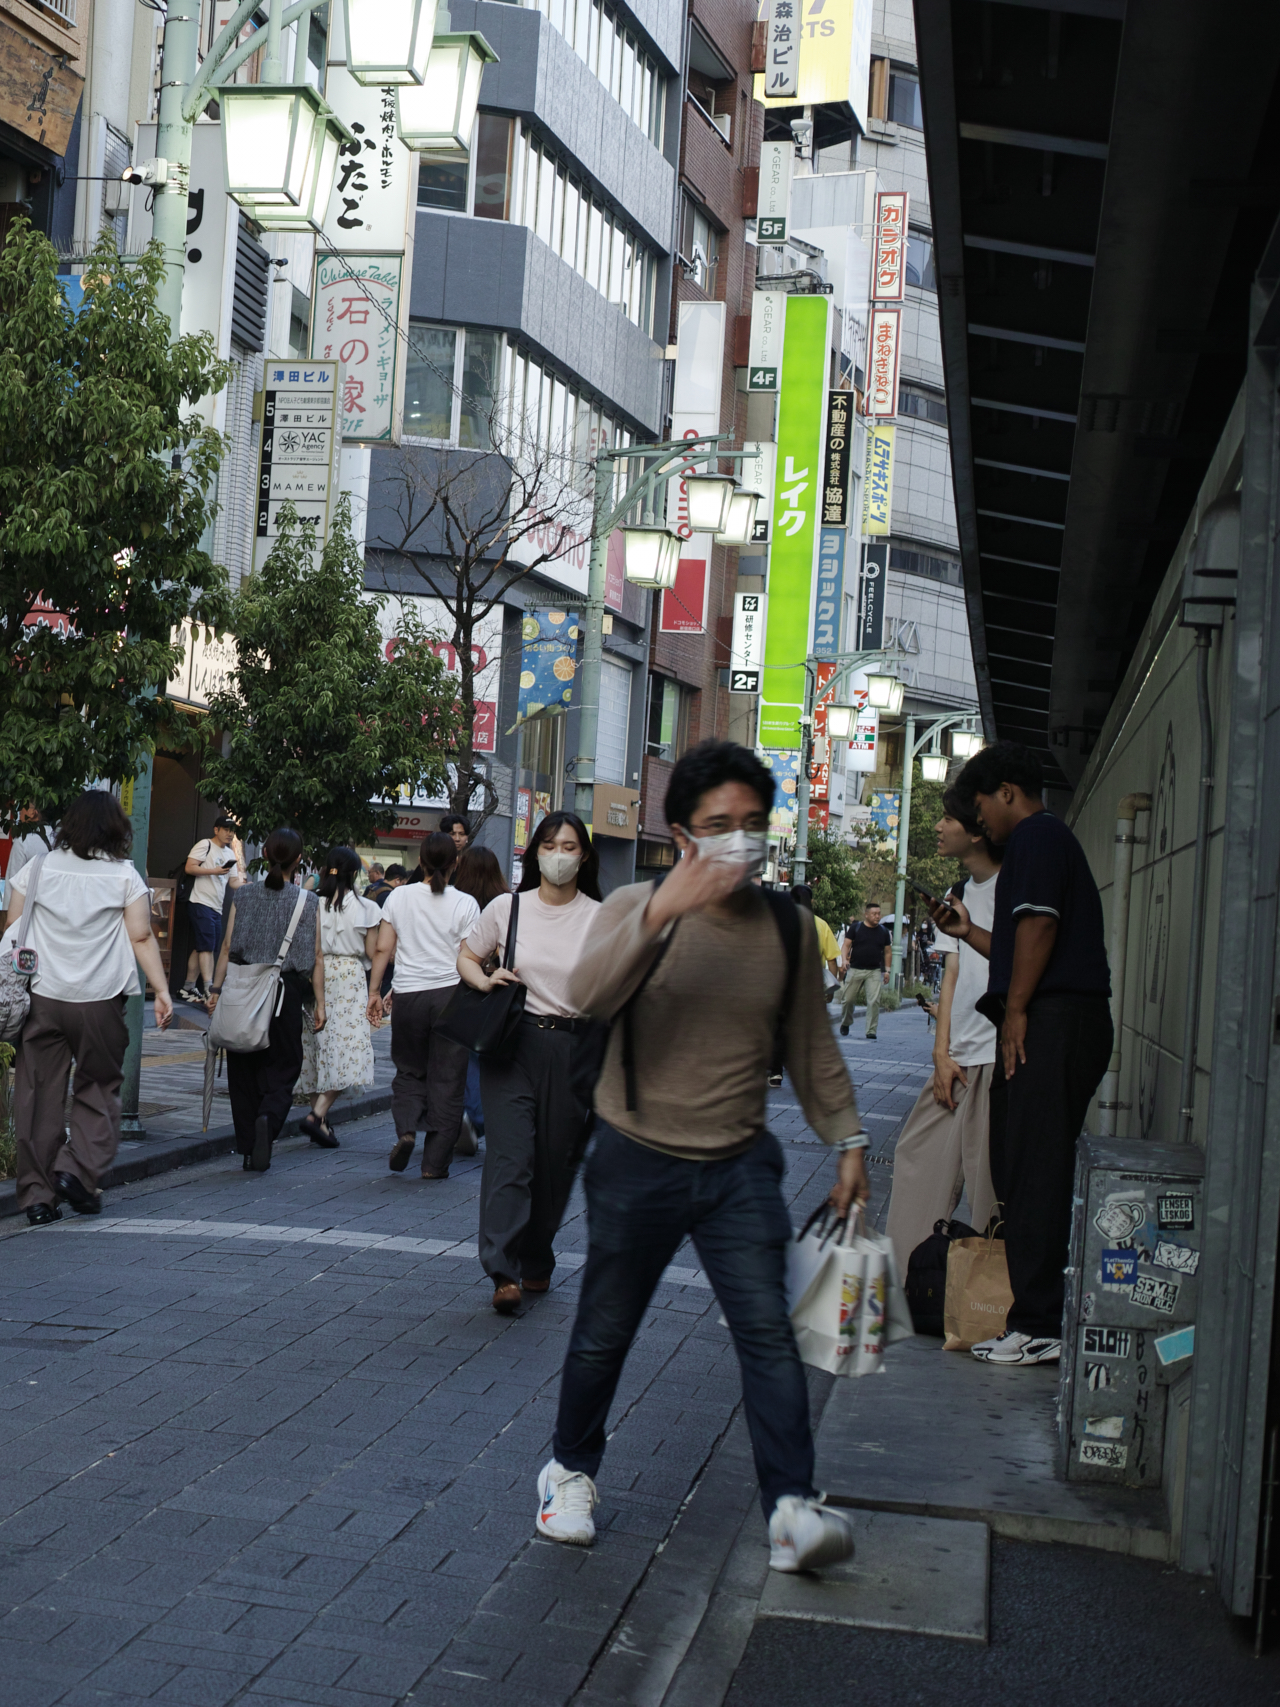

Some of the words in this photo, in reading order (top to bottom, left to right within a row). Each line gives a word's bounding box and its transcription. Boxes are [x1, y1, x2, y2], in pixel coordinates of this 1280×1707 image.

[771, 1, 793, 89] 森治ビル
[336, 121, 377, 230] ふたご
[771, 155, 781, 185] GEAR
[761, 221, 783, 236] 5F
[879, 205, 901, 287] カラオケ
[321, 265, 368, 286] Chinese
[368, 265, 398, 289] Table
[763, 304, 773, 334] GEAR
[336, 297, 371, 414] 石の家
[875, 321, 894, 405] まねきねこ
[273, 370, 330, 383] 澤田ビル
[752, 370, 775, 385] 4F
[266, 401, 275, 417] 5
[279, 413, 327, 424] 澤田ビル
[263, 439, 272, 453] 4
[301, 431, 326, 444] YAC
[301, 443, 325, 451] Agency
[261, 475, 270, 490] 3
[870, 437, 891, 525] ムラサキスポーツ
[778, 455, 809, 537] レイク
[258, 512, 268, 527] 2
[814, 535, 840, 645] ヨシックス
[865, 581, 875, 635] FEELCYCLE
[744, 615, 754, 667] 研修センター
[733, 673, 758, 690] 2F
[851, 741, 869, 750] ATM
[1159, 1199, 1190, 1210] TENSER
[1160, 1209, 1190, 1220] LTSKOG
